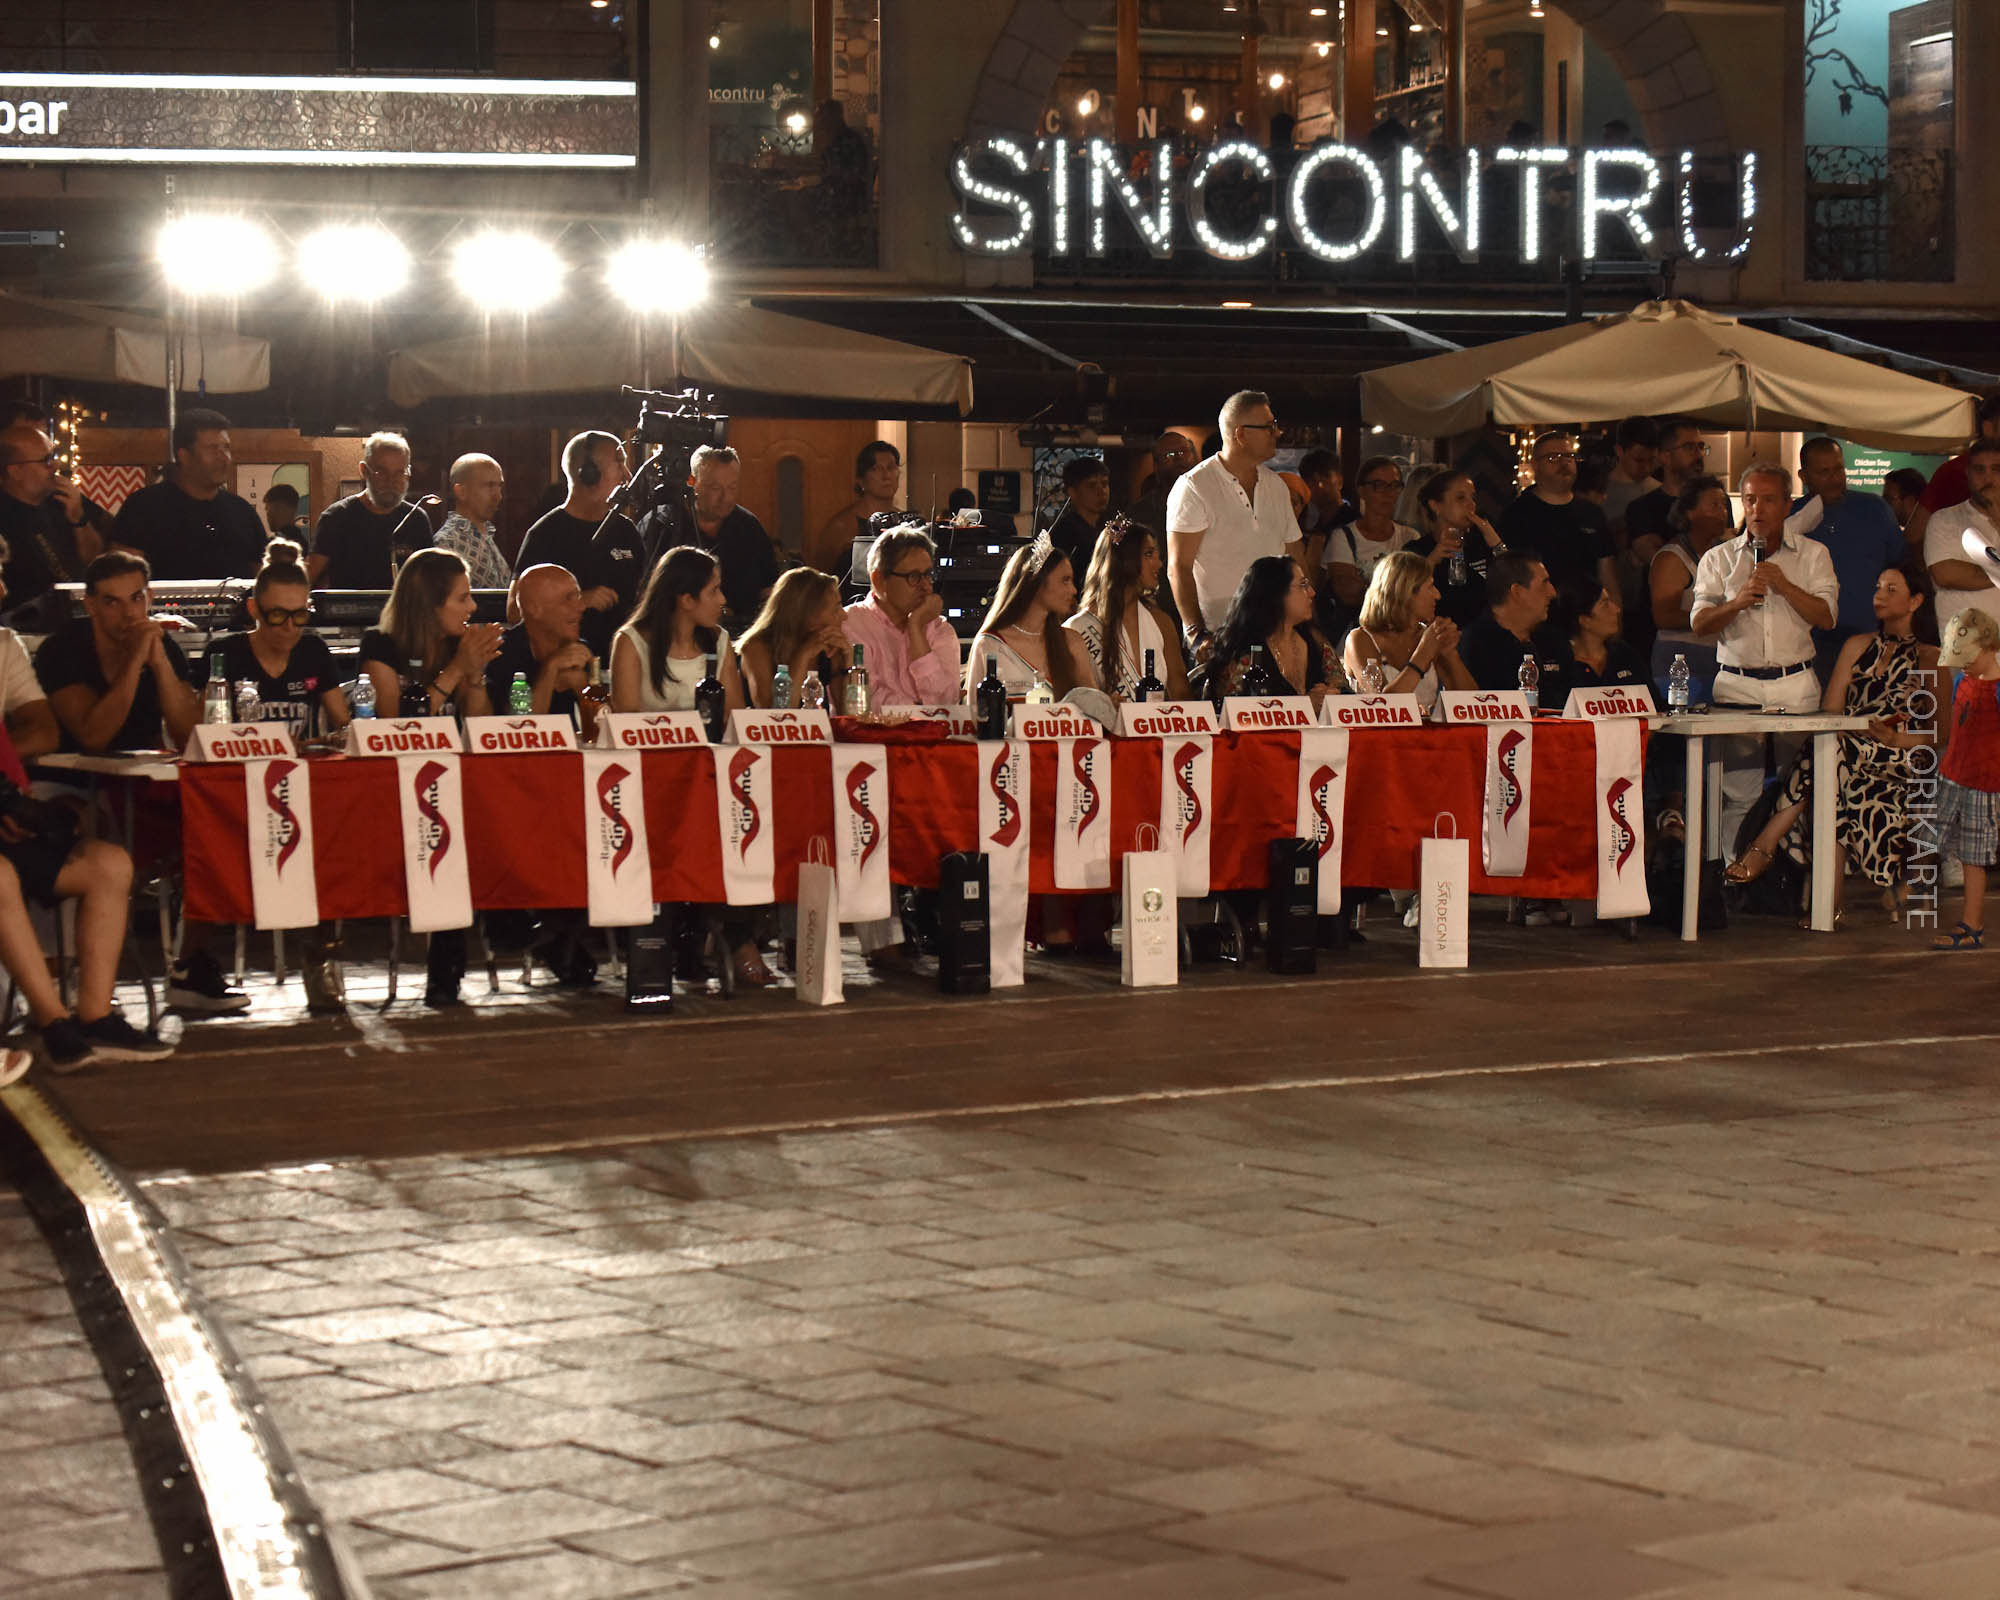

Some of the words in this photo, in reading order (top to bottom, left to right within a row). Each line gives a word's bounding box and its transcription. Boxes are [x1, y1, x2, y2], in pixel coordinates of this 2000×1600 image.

[951, 138, 1757, 261] SINCONTRU
[1338, 707, 1413, 723] GIURIA
[1453, 704, 1525, 721] GIURIA
[1585, 698, 1649, 716] GIURIA
[1023, 719, 1095, 738] GIURIA
[1133, 716, 1211, 735] GIURIA
[1237, 711, 1310, 728] GIURIA
[367, 732, 453, 752] GIURIA
[480, 730, 567, 750] GIURIA
[622, 727, 699, 746] GIURIA
[746, 724, 825, 742] GIURIA
[211, 739, 288, 758] GIURIA
[1436, 880, 1448, 951] SARDEGNA
